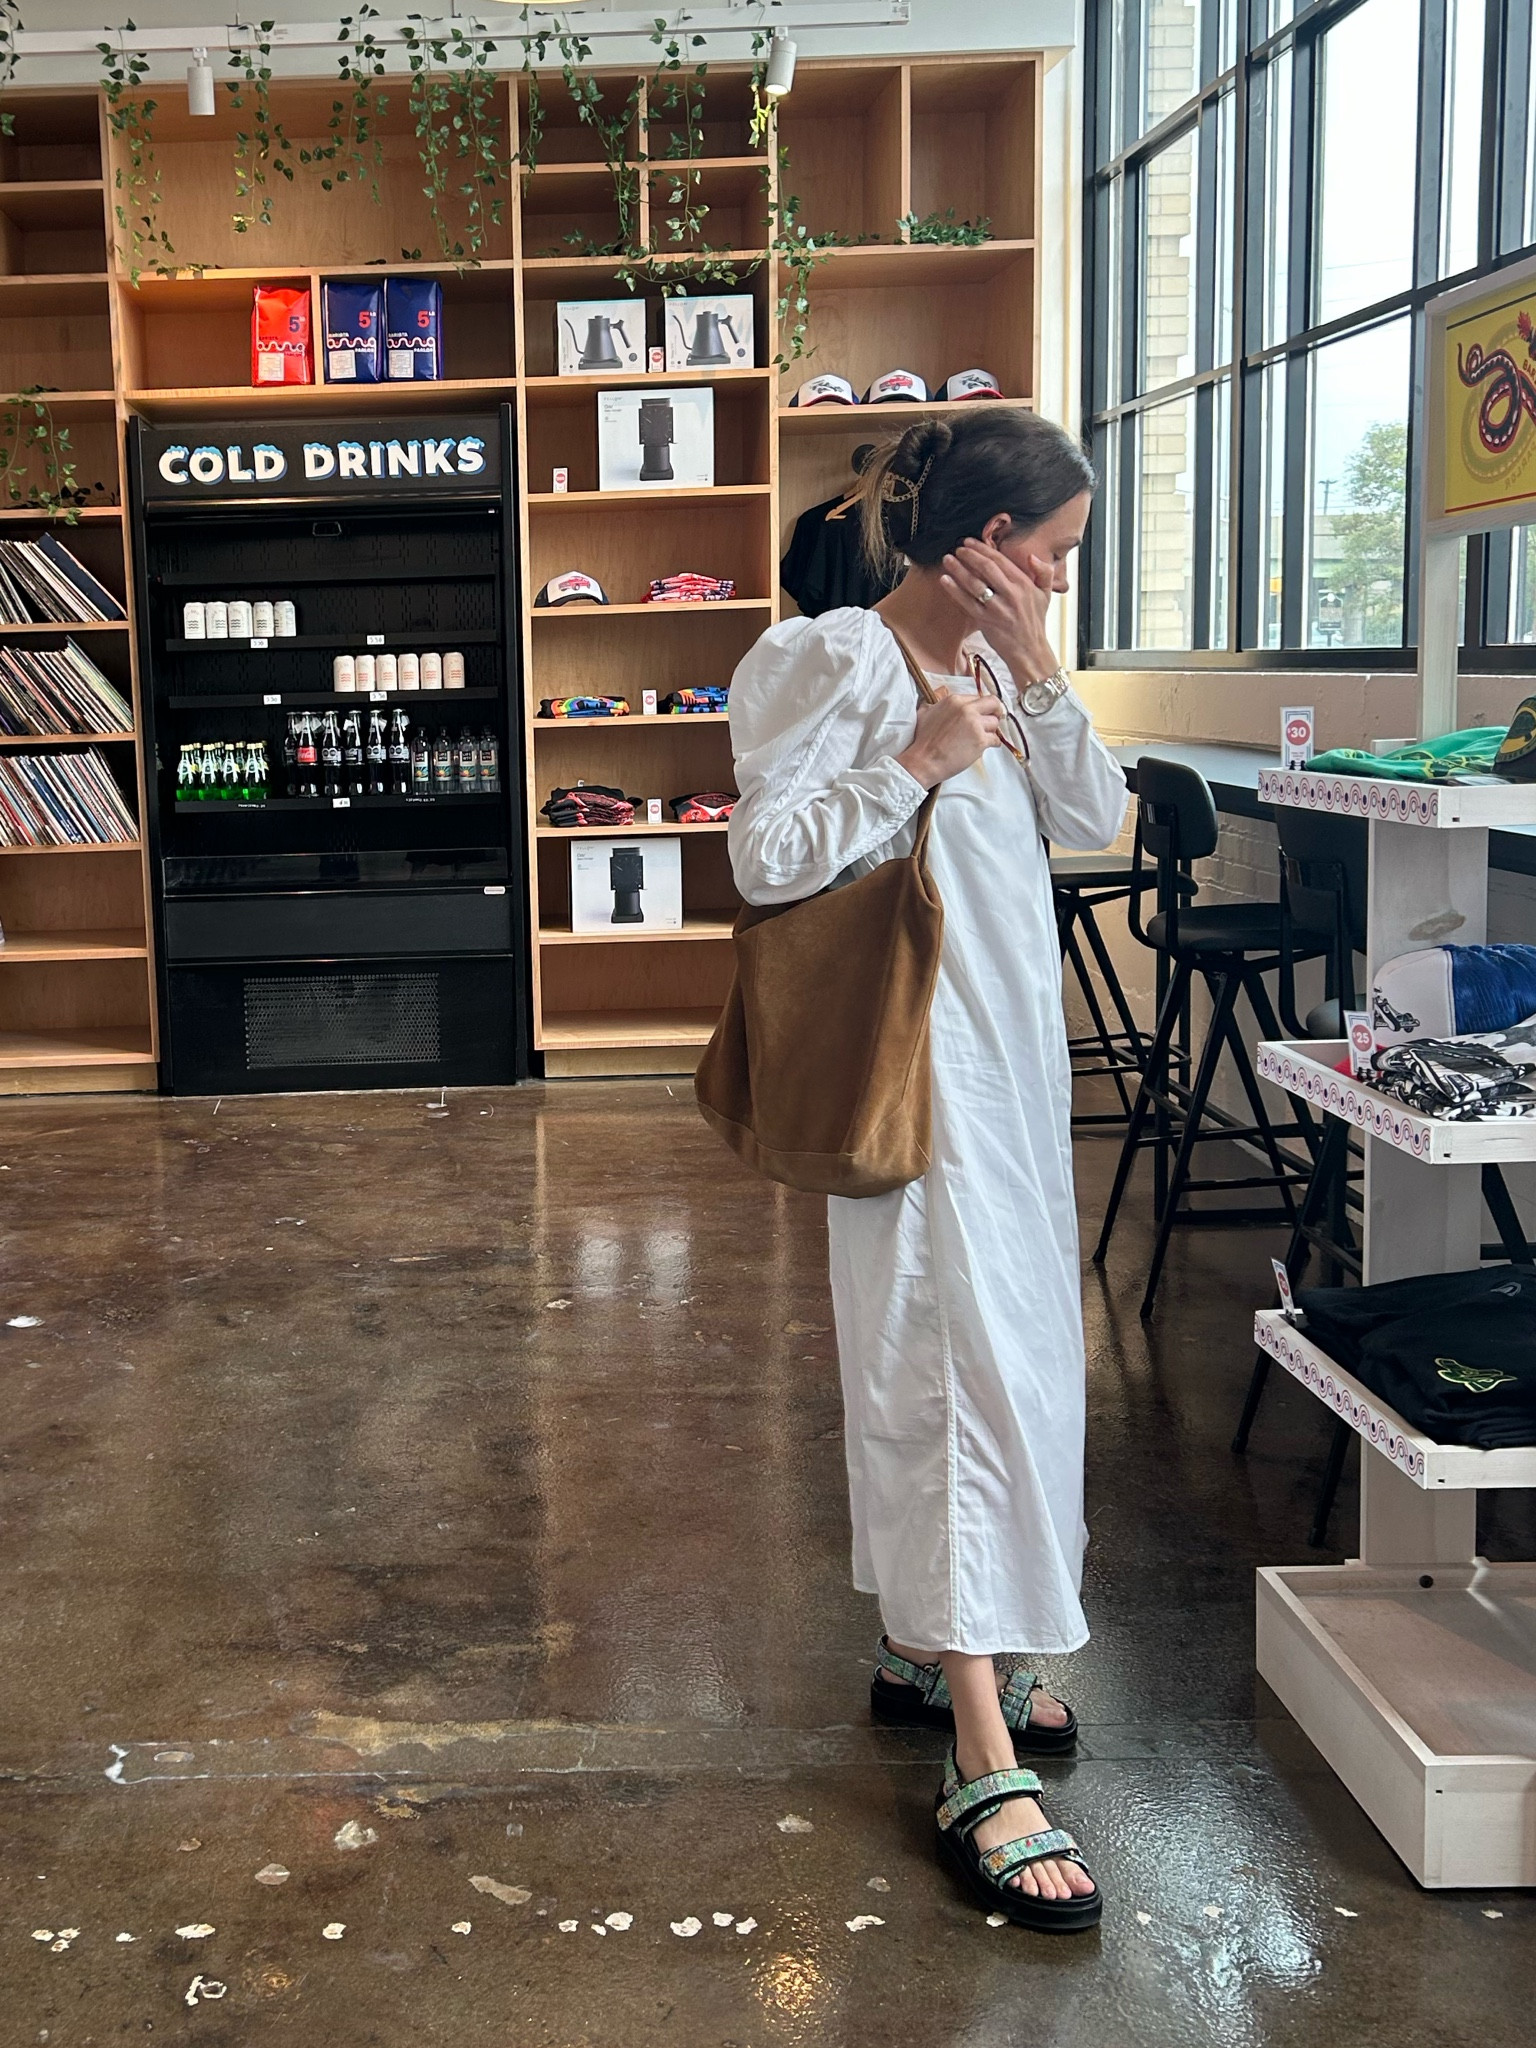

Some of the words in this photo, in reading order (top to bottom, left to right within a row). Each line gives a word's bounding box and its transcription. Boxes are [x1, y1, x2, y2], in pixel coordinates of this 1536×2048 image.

[289, 316, 300, 332] 5
[358, 311, 371, 328] 5
[417, 310, 430, 328] 5
[1523, 359, 1536, 384] BAR
[158, 443, 287, 485] COLD
[303, 436, 487, 480] DRINKS
